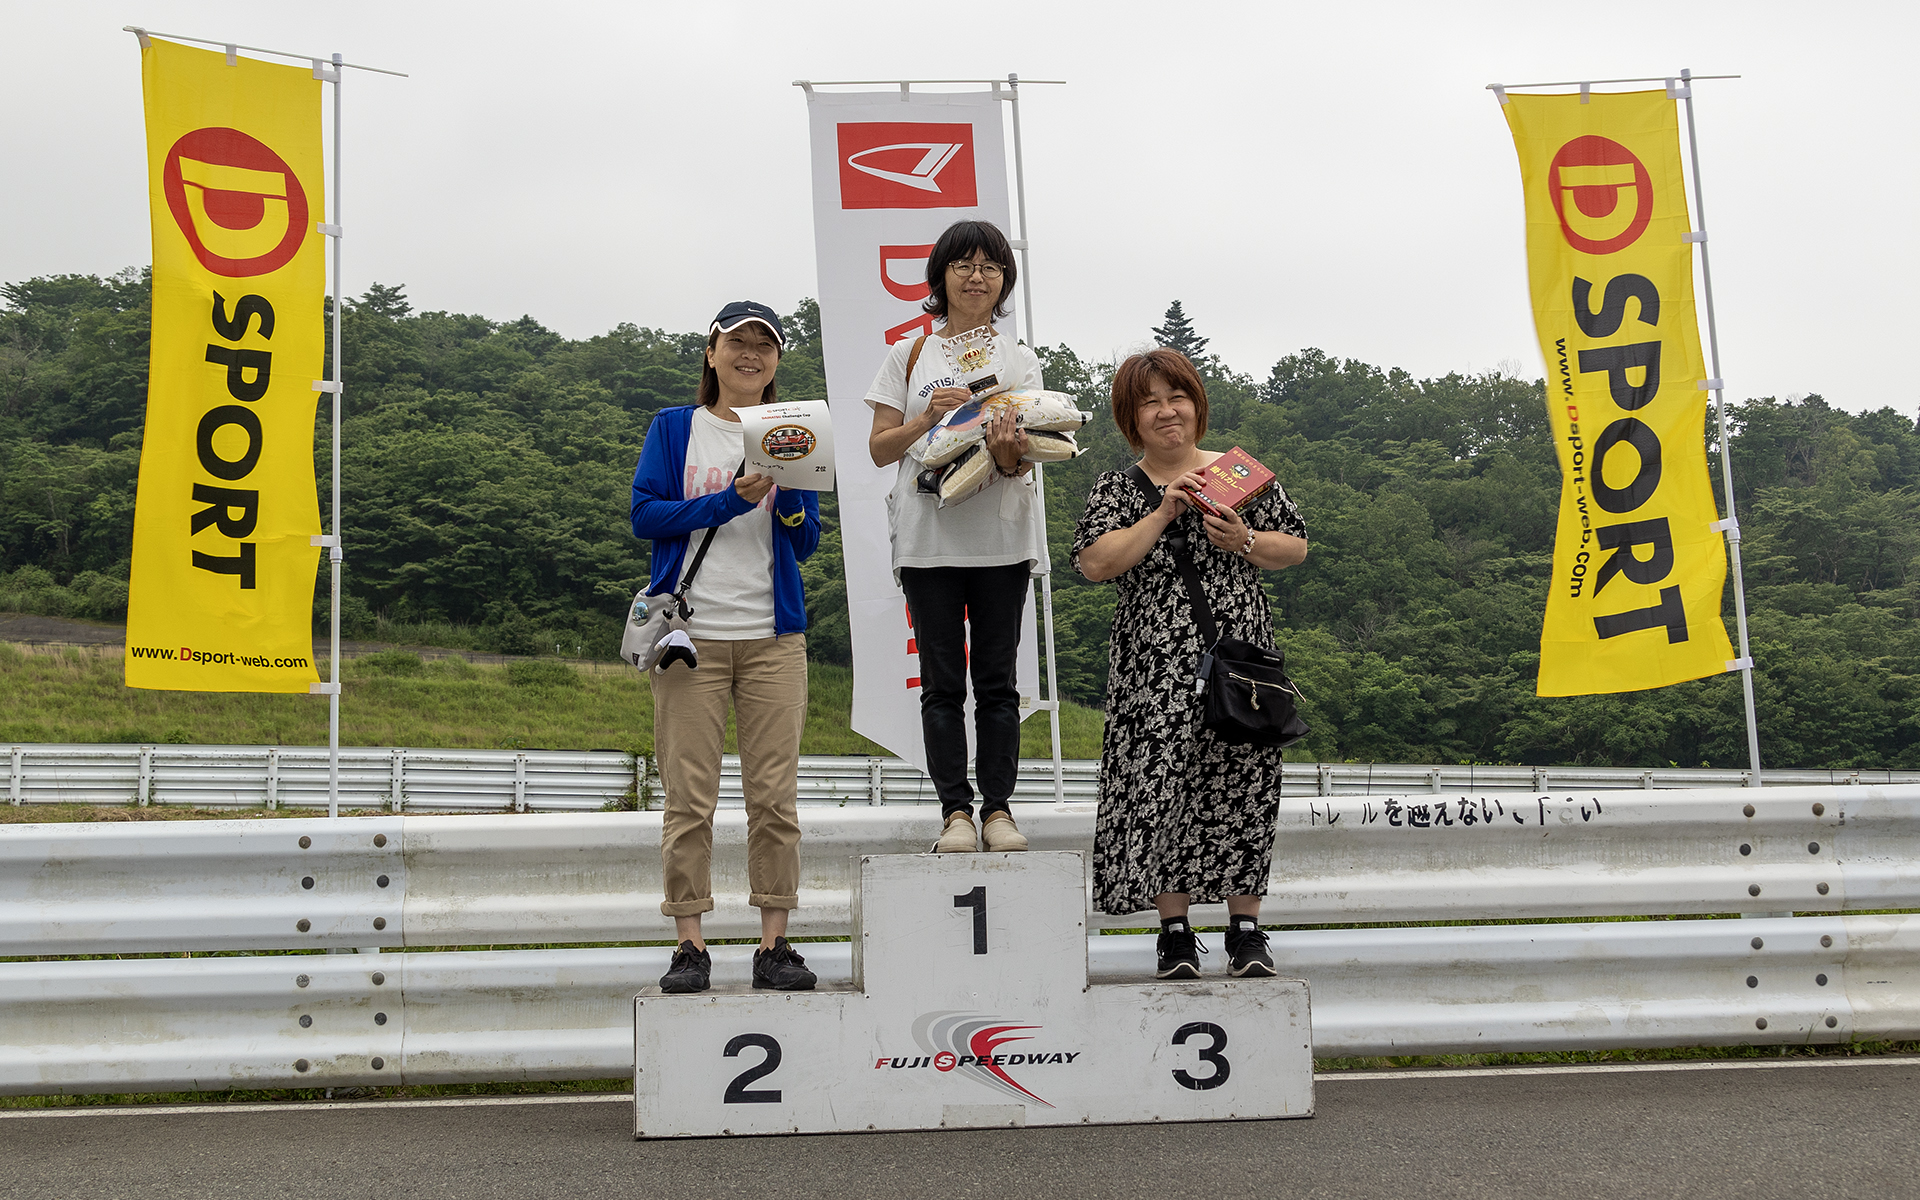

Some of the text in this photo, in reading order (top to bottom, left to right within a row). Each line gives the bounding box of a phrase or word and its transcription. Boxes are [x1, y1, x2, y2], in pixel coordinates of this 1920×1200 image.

[174, 150, 297, 590] D SPORT
[1553, 155, 1689, 645] D SPORT
[1554, 338, 1592, 598] www.Dsport-web.com
[131, 646, 309, 668] www.Dsport-web.com
[954, 887, 987, 954] 1
[723, 1034, 781, 1103] 2
[875, 1052, 1081, 1070] FUJI SPEEDWAY
[1172, 1022, 1230, 1091] 3
